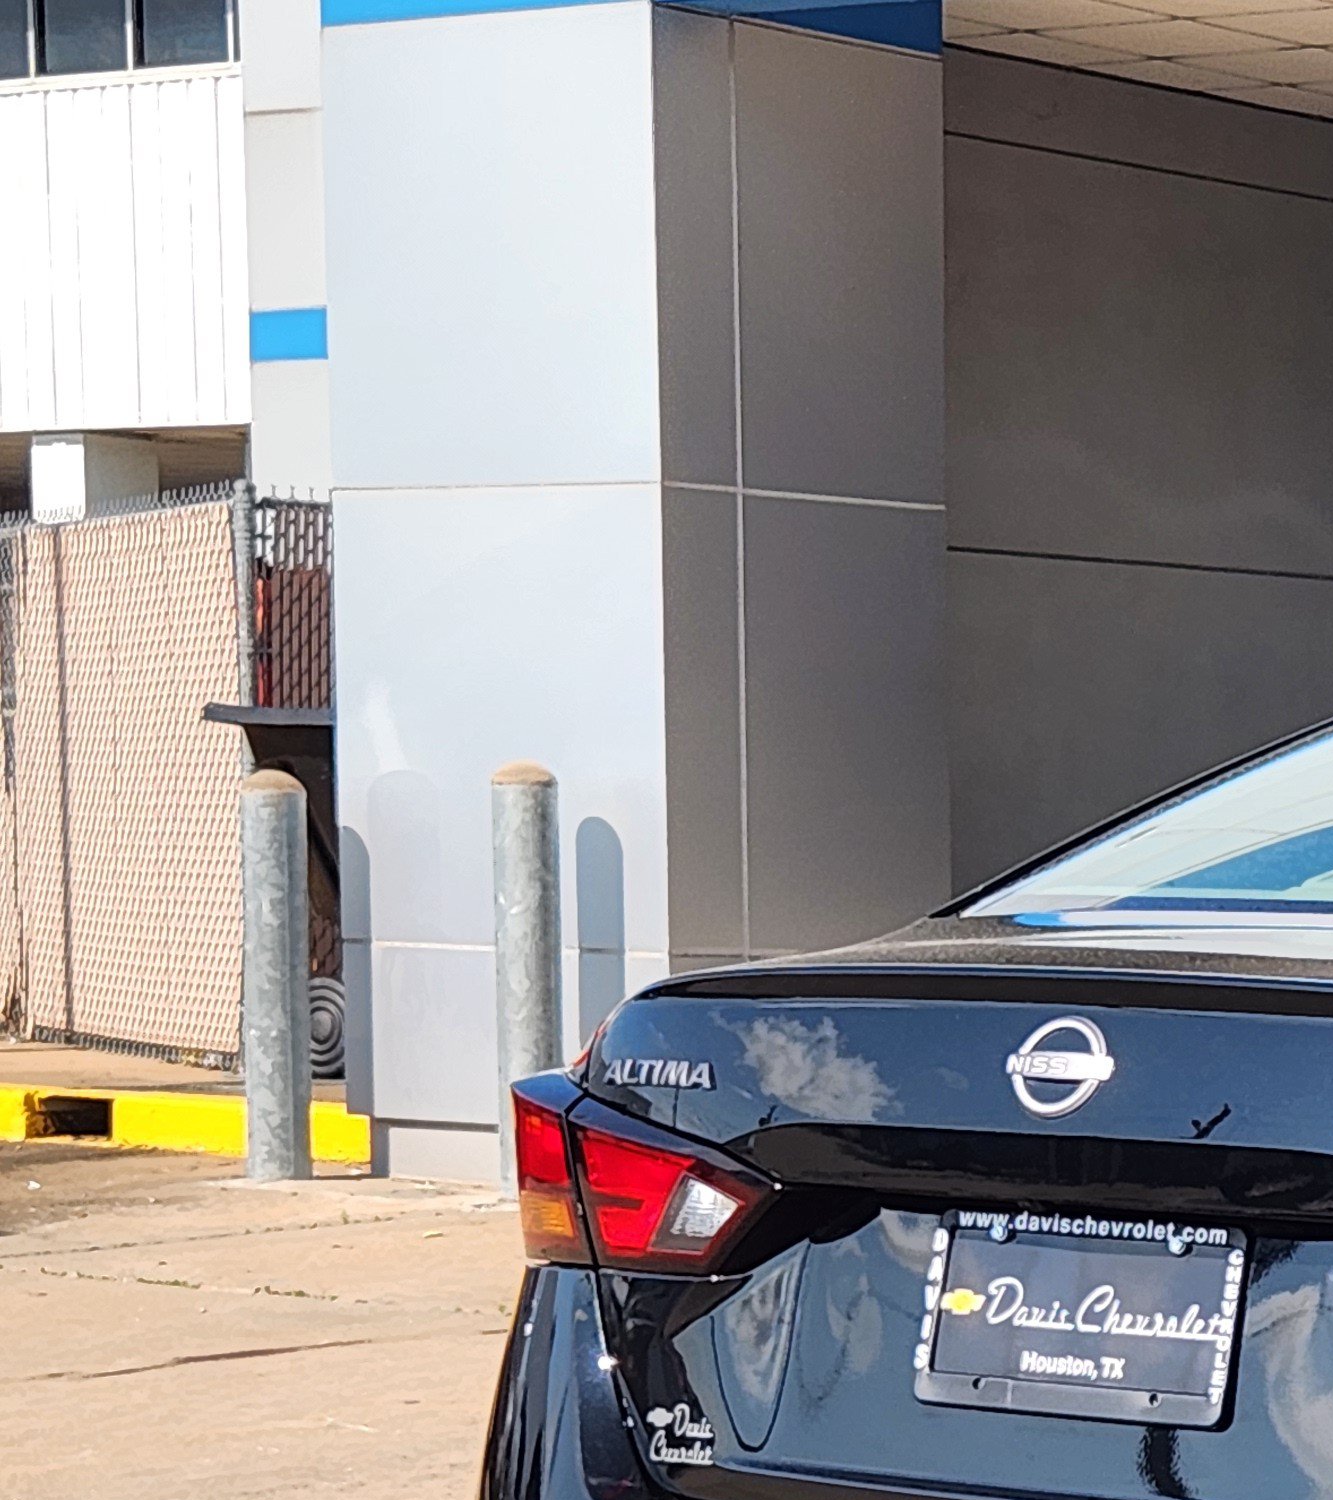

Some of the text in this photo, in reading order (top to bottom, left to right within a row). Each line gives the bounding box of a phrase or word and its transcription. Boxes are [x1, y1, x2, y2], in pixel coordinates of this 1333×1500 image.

[603, 1059, 712, 1088] ALTIMA
[1006, 1053, 1106, 1079] NISS
[914, 1227, 949, 1369] DAVIS
[986, 1276, 1220, 1340] Davis Chevrolet
[1019, 1350, 1126, 1380] Houston, TX
